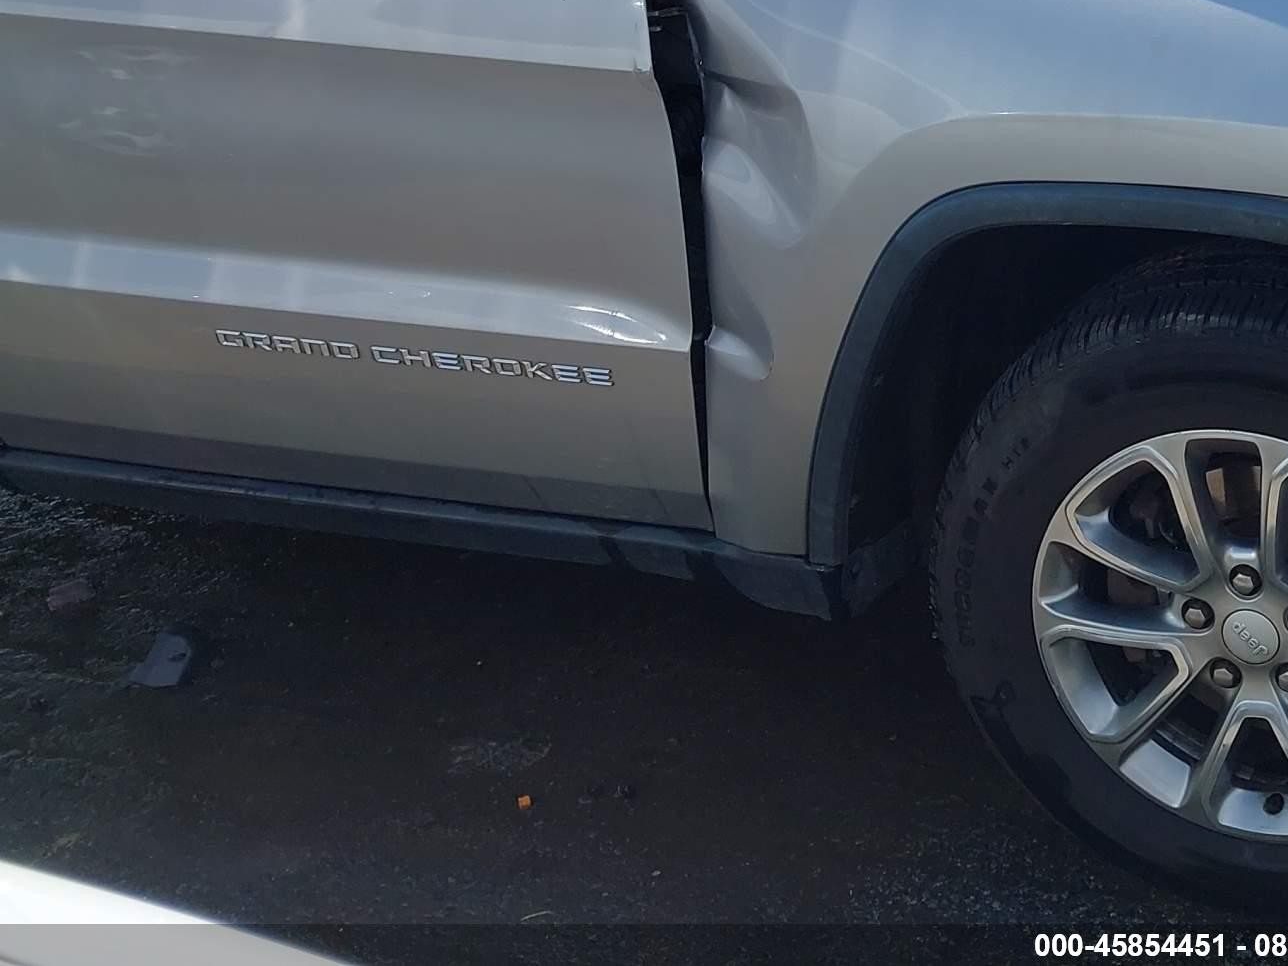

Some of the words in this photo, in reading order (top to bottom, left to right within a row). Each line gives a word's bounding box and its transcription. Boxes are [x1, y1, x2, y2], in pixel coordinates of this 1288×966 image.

[215, 329, 360, 360] GRAND
[370, 345, 615, 387] CHEROKEE
[1232, 621, 1269, 656] Jeep
